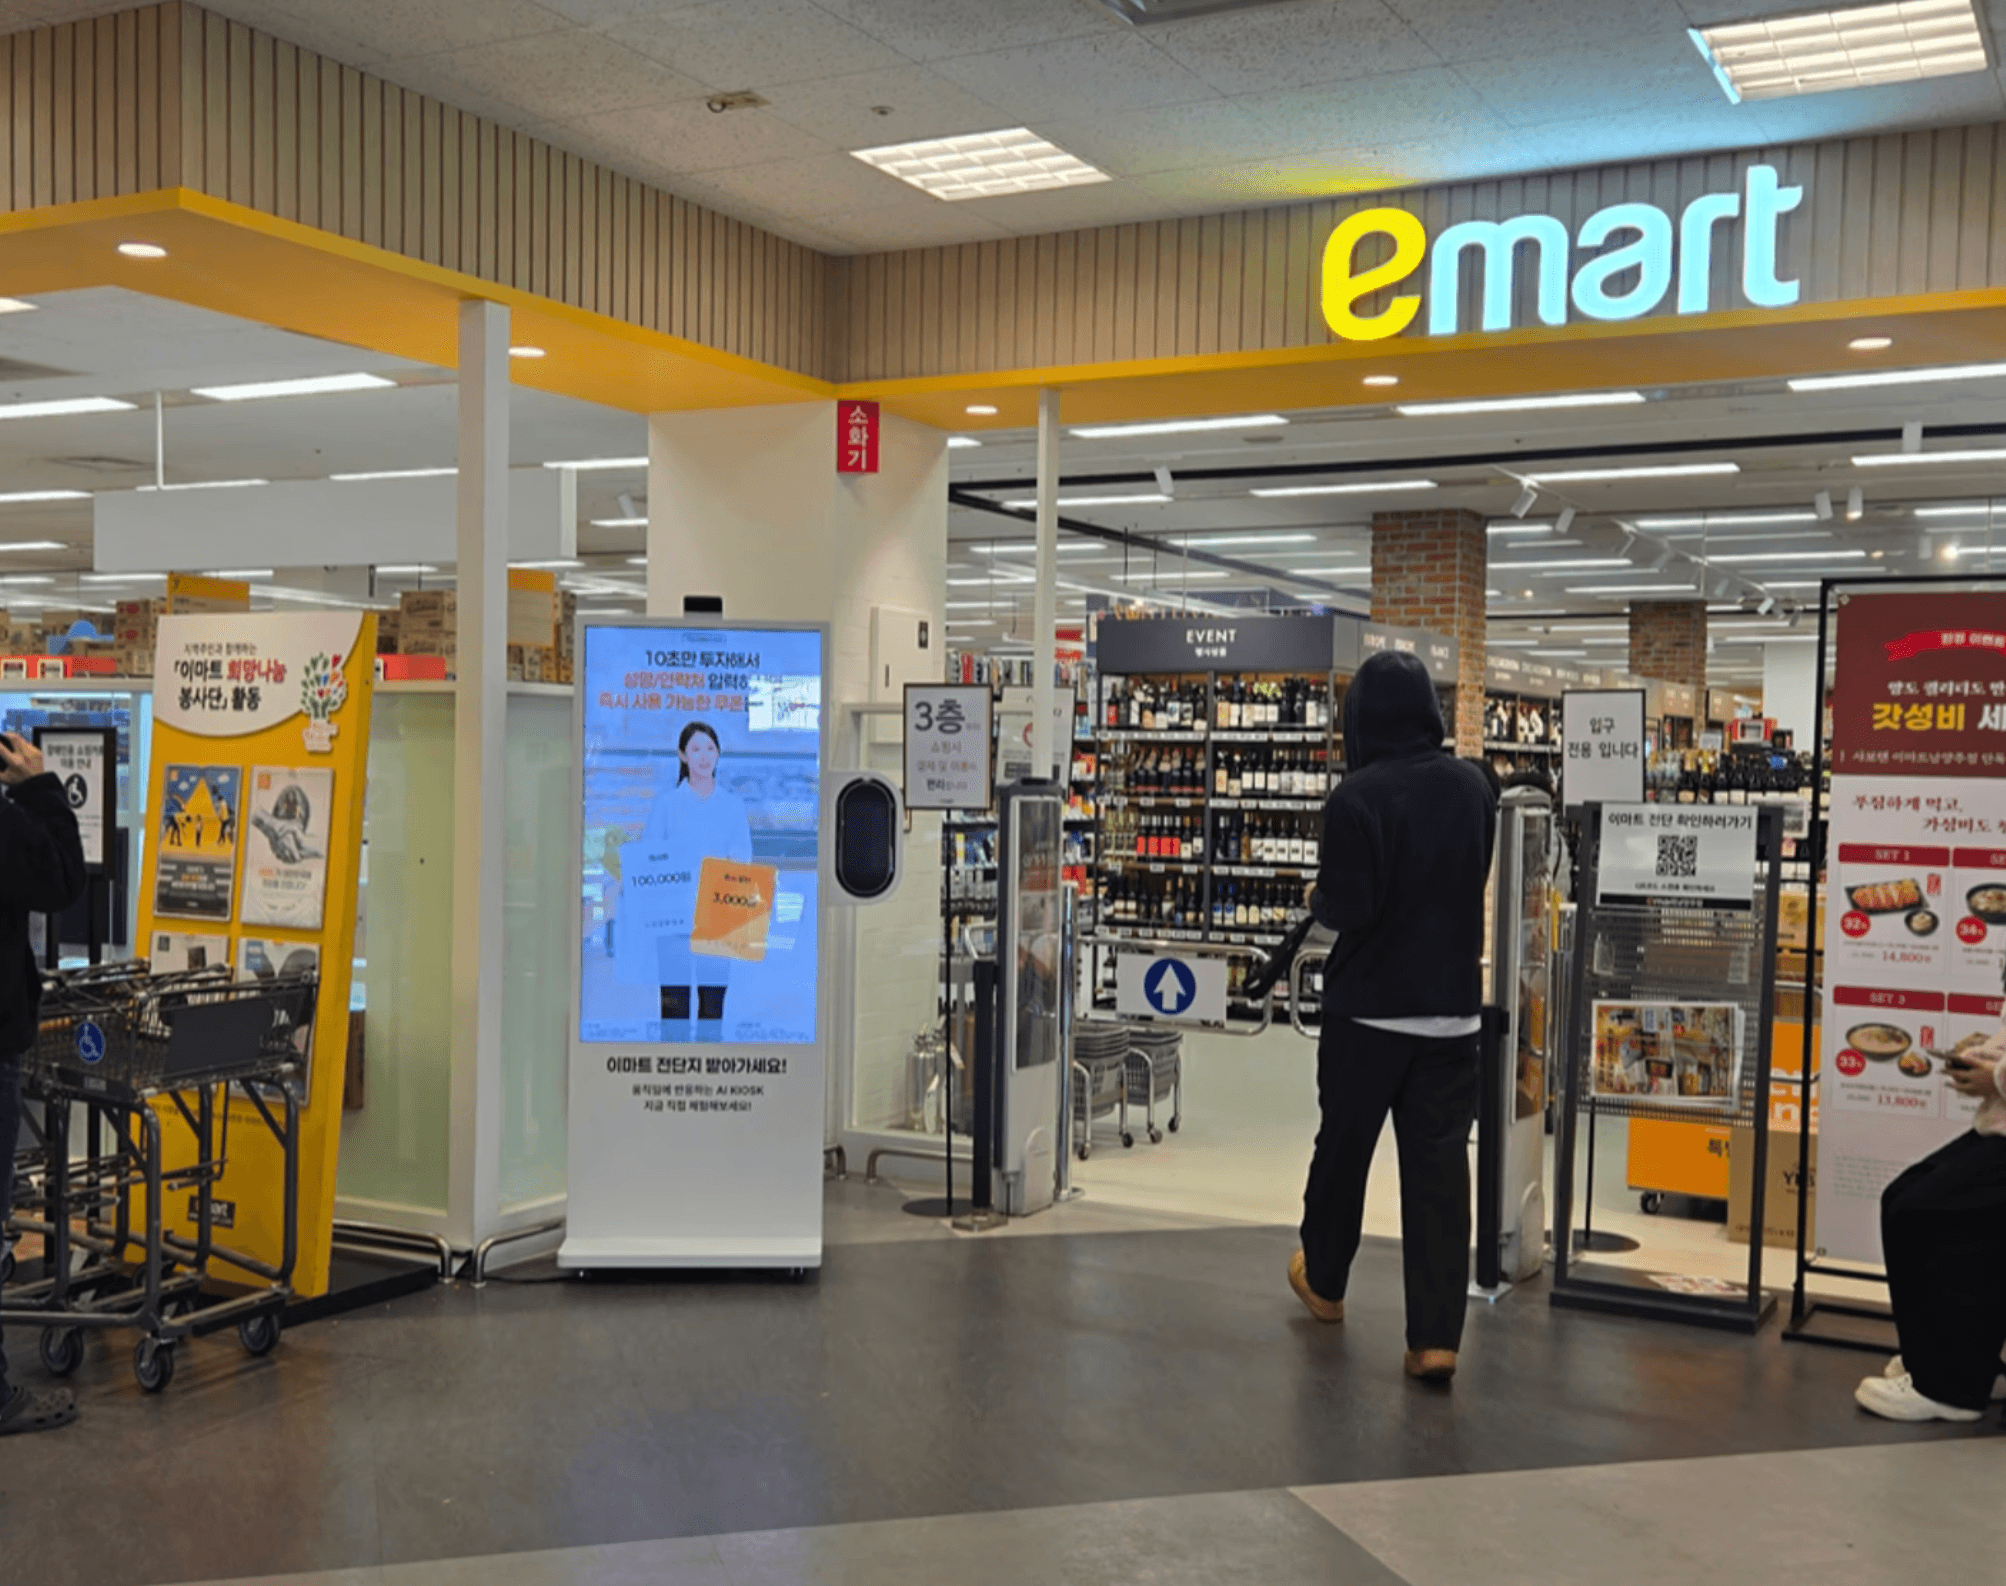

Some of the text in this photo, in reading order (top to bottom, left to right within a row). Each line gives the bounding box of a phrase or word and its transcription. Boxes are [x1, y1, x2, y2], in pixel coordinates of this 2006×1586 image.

[1321, 165, 1803, 341] emart
[848, 405, 869, 470] 소화기
[1186, 629, 1237, 643] EVENT
[646, 650, 760, 668] 10초만 투자해서
[226, 660, 286, 683] 희망나눔
[232, 687, 260, 710] 활동
[633, 693, 662, 710] 사용
[666, 693, 711, 711] 가능한
[1590, 717, 1615, 734] 입구
[1872, 703, 1965, 731] 갓성비
[1567, 742, 1638, 759] 전용 입니다
[1853, 795, 1963, 813] 푸짐하게 먹고,
[1608, 813, 1752, 830] 이마트 전단 확인하러가기
[1875, 850, 1910, 861] SET 1
[1869, 992, 1894, 1004] SET
[606, 1056, 787, 1075] 이마트 전단지 받아가세요!
[632, 1084, 764, 1096] 움직임에 반응하는 AI KIOSK
[644, 1100, 752, 1112] 지금 직접 체험해보세요!
